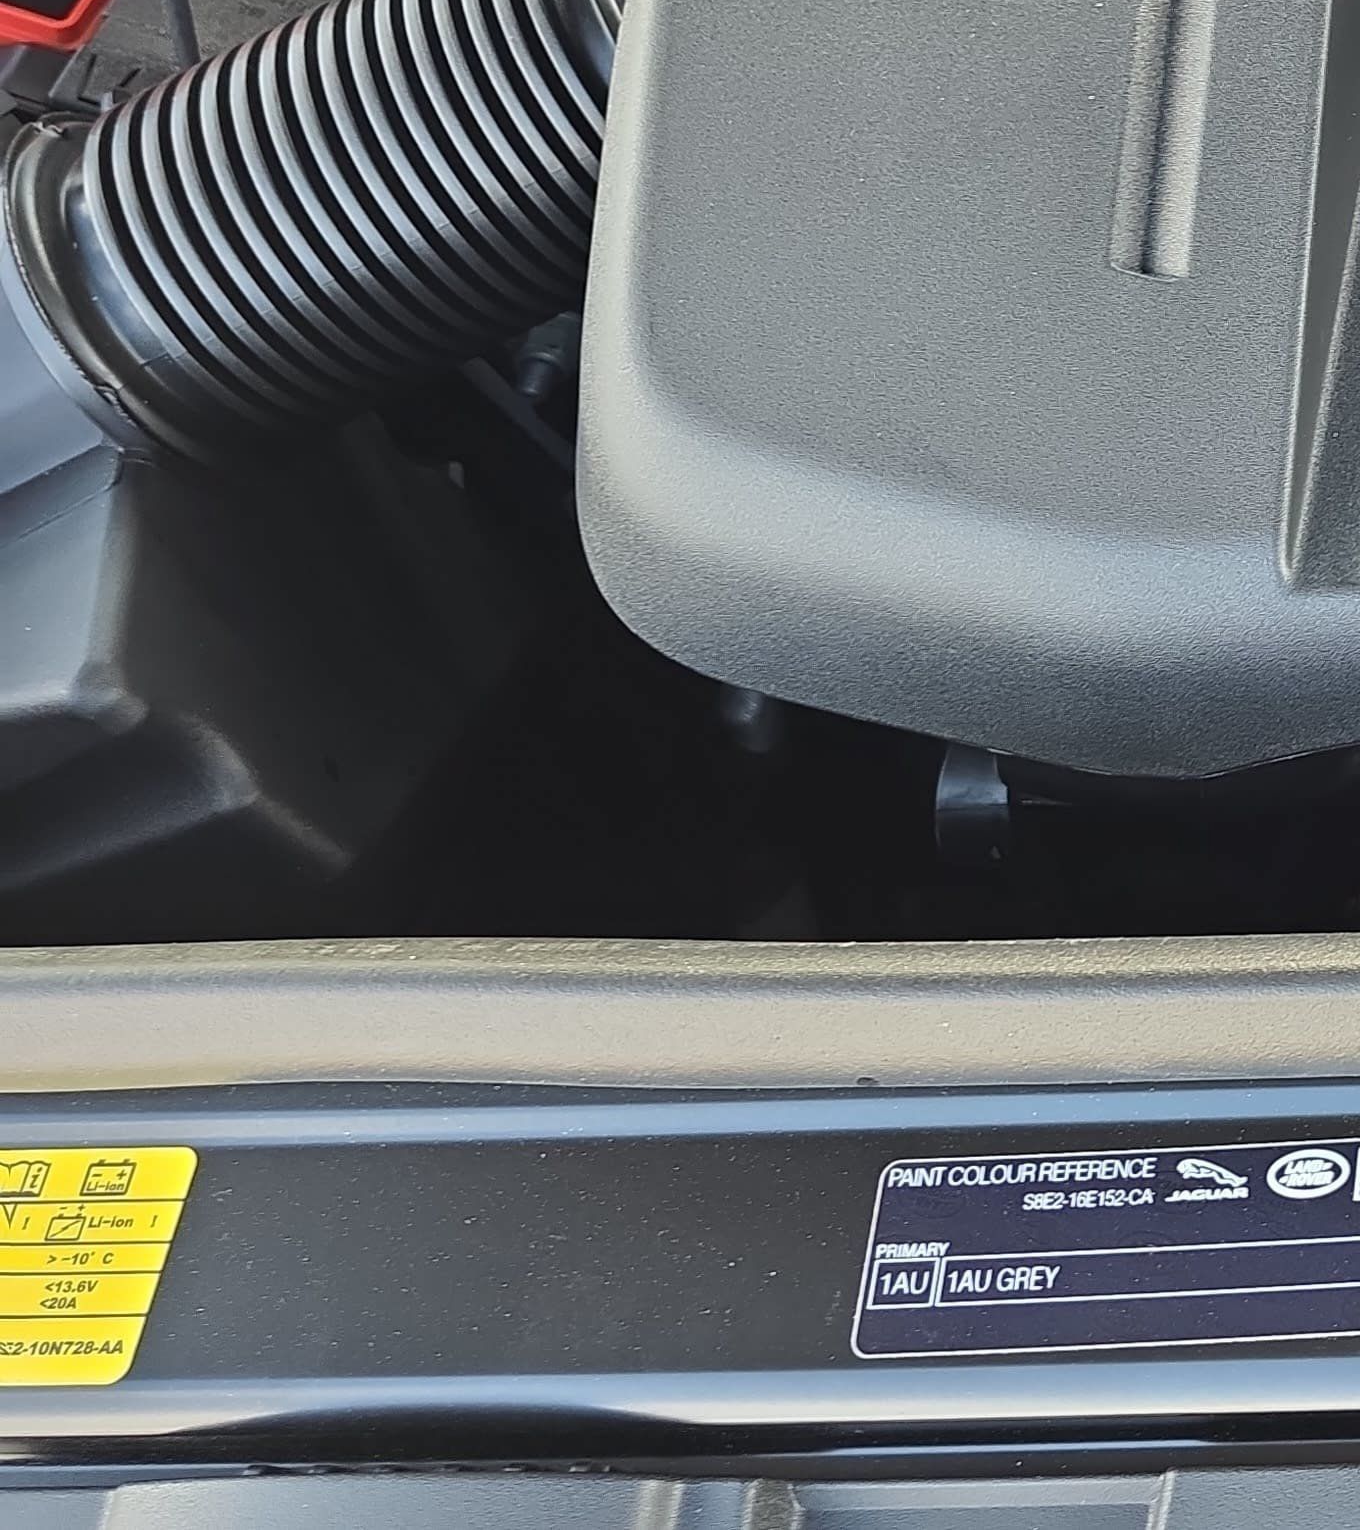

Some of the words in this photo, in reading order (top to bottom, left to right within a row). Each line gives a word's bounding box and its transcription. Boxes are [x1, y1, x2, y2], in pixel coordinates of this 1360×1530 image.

[887, 1166, 947, 1188] PAINT
[948, 1162, 1036, 1187] COLOUR
[1038, 1157, 1158, 1183] REFERENCE
[86, 1180, 125, 1192] Li-ion
[1164, 1186, 1249, 1203] JAGUAR
[1021, 1188, 1156, 1211] S8E2-16E152-CA
[87, 1216, 134, 1228] Li-ion
[874, 1242, 951, 1259] PRIMARY
[44, 1280, 98, 1293] <13.6V
[880, 1270, 930, 1296] 1AU
[947, 1268, 993, 1293] 1AU
[996, 1265, 1061, 1292] GREY
[39, 1297, 77, 1309] <20A
